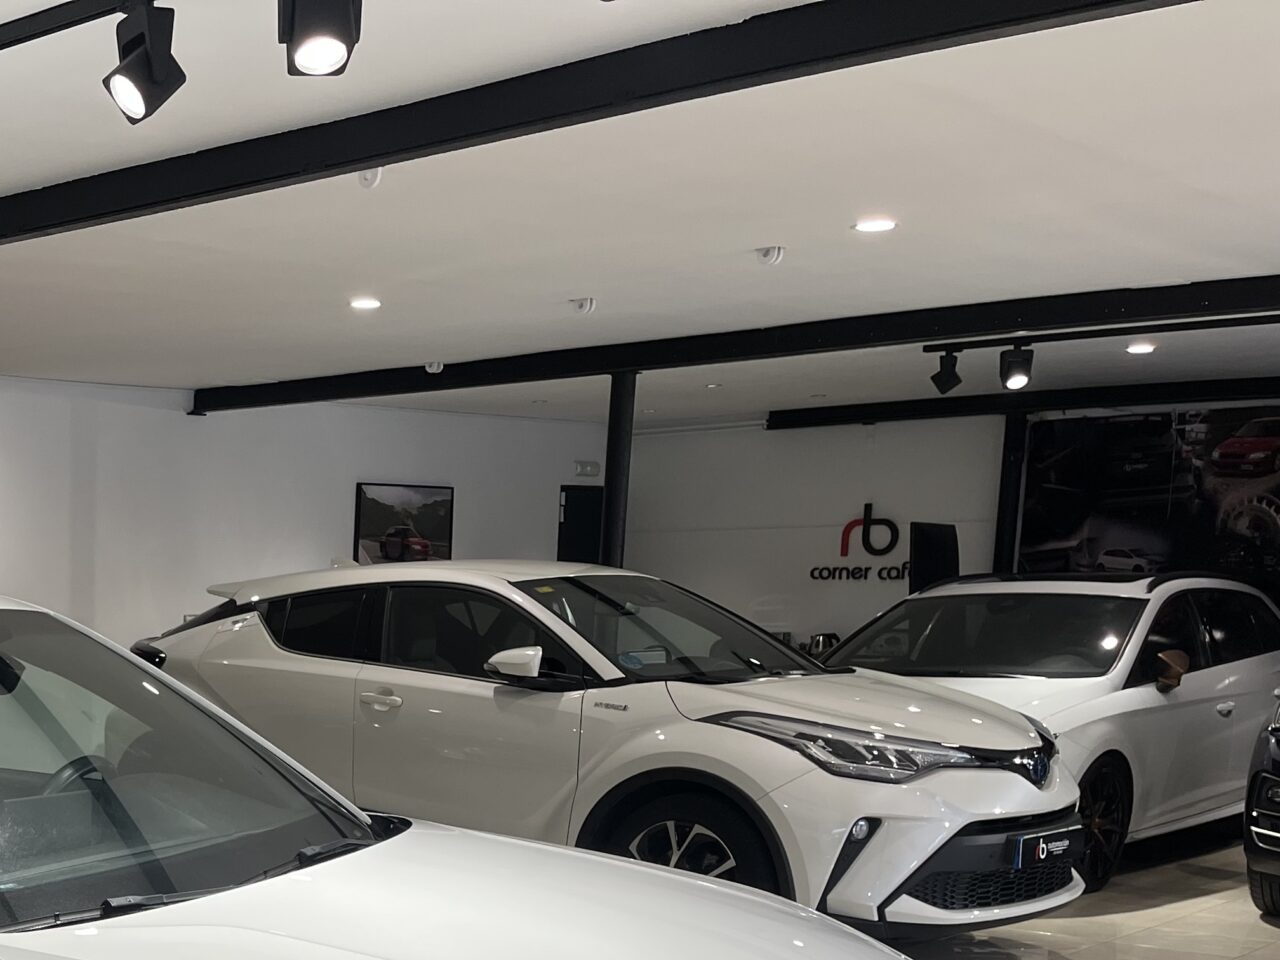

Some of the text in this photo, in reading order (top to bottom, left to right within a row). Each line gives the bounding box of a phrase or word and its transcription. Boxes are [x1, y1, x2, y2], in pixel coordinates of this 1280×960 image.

[840, 503, 899, 556] rb
[810, 561, 911, 581] corner caf
